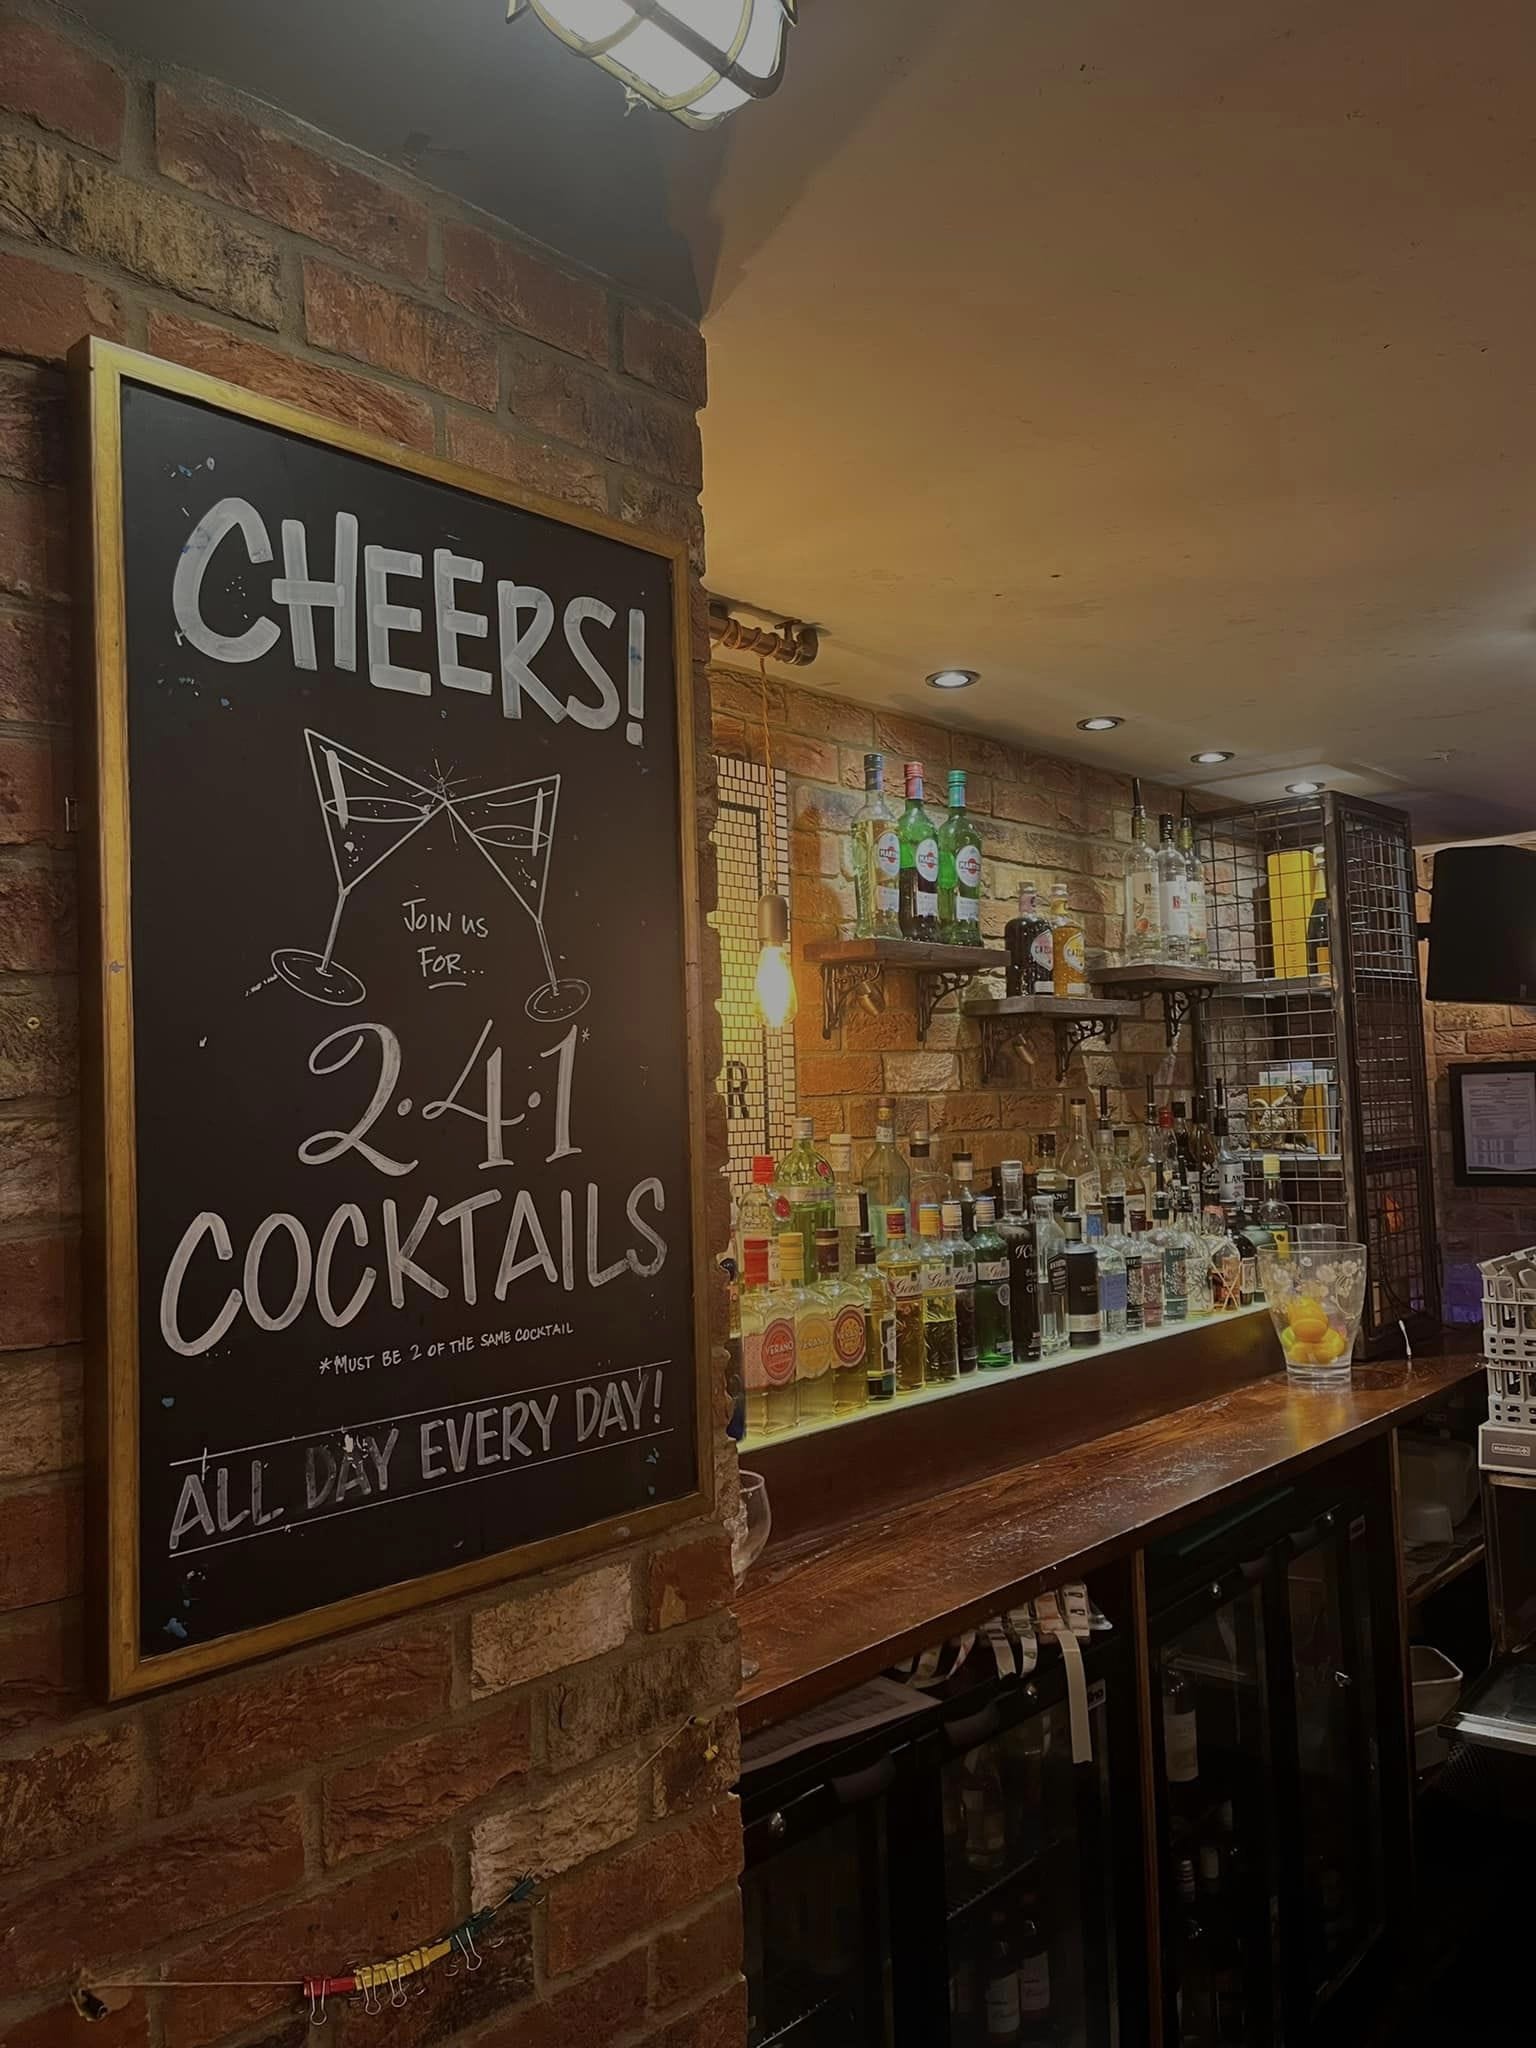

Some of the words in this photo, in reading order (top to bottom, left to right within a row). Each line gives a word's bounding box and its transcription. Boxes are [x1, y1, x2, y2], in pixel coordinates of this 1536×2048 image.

[173, 497, 645, 745] CHEERS!
[402, 898, 452, 933] JOIN
[417, 946, 485, 977] FOR...
[160, 1177, 667, 1357] COCKTAILS
[382, 1349, 402, 1367] BE
[409, 1343, 422, 1360] 2
[427, 1342, 445, 1357] OF
[449, 1336, 475, 1354] THE
[480, 1330, 511, 1347] SAME
[515, 1322, 574, 1342] COCKTAIL
[169, 1460, 285, 1550] ALL
[306, 1428, 399, 1509] DAY
[420, 1394, 559, 1479] EVERY
[576, 1369, 663, 1442] DAY!
